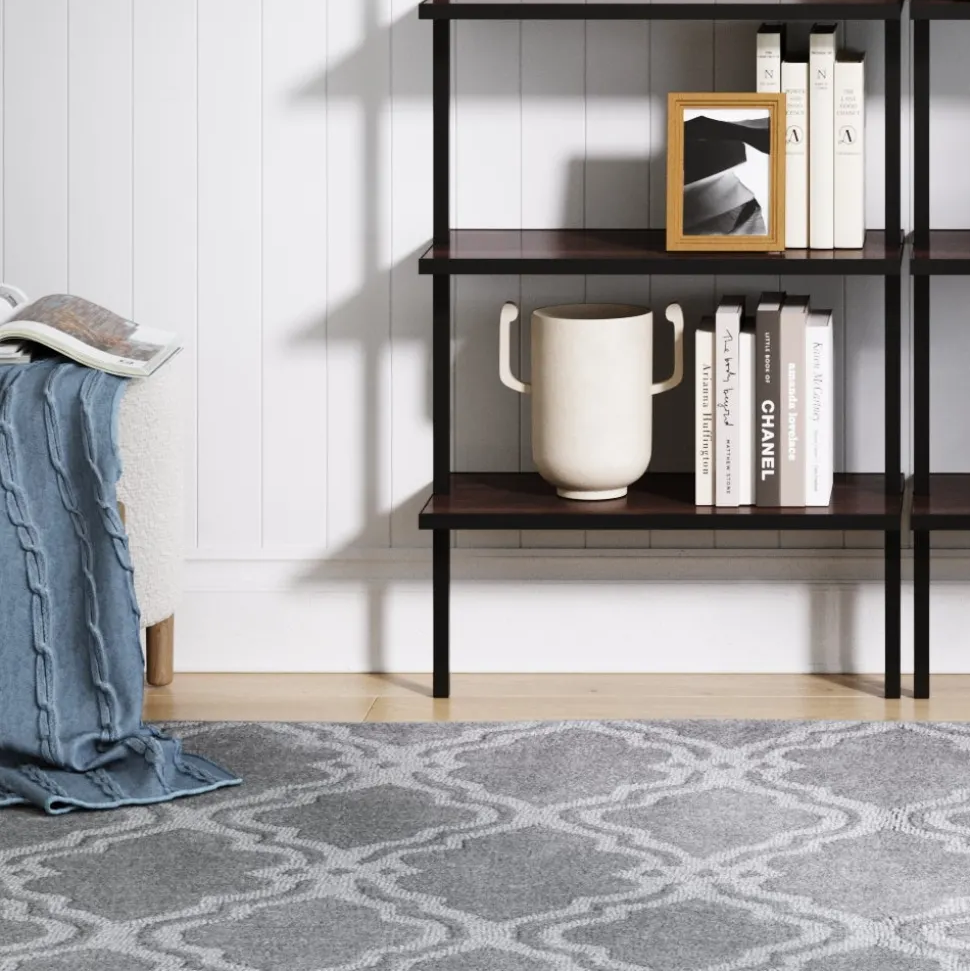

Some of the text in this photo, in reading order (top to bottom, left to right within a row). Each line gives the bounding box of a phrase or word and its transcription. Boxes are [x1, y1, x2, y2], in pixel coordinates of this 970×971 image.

[764, 69, 774, 79] N
[817, 69, 827, 79] N
[717, 329, 736, 427] The body beyond
[765, 374, 771, 384] OF
[788, 363, 798, 461] amanda lovelace
[700, 364, 712, 475] Arianna Huffington
[761, 400, 775, 481] CHANEL
